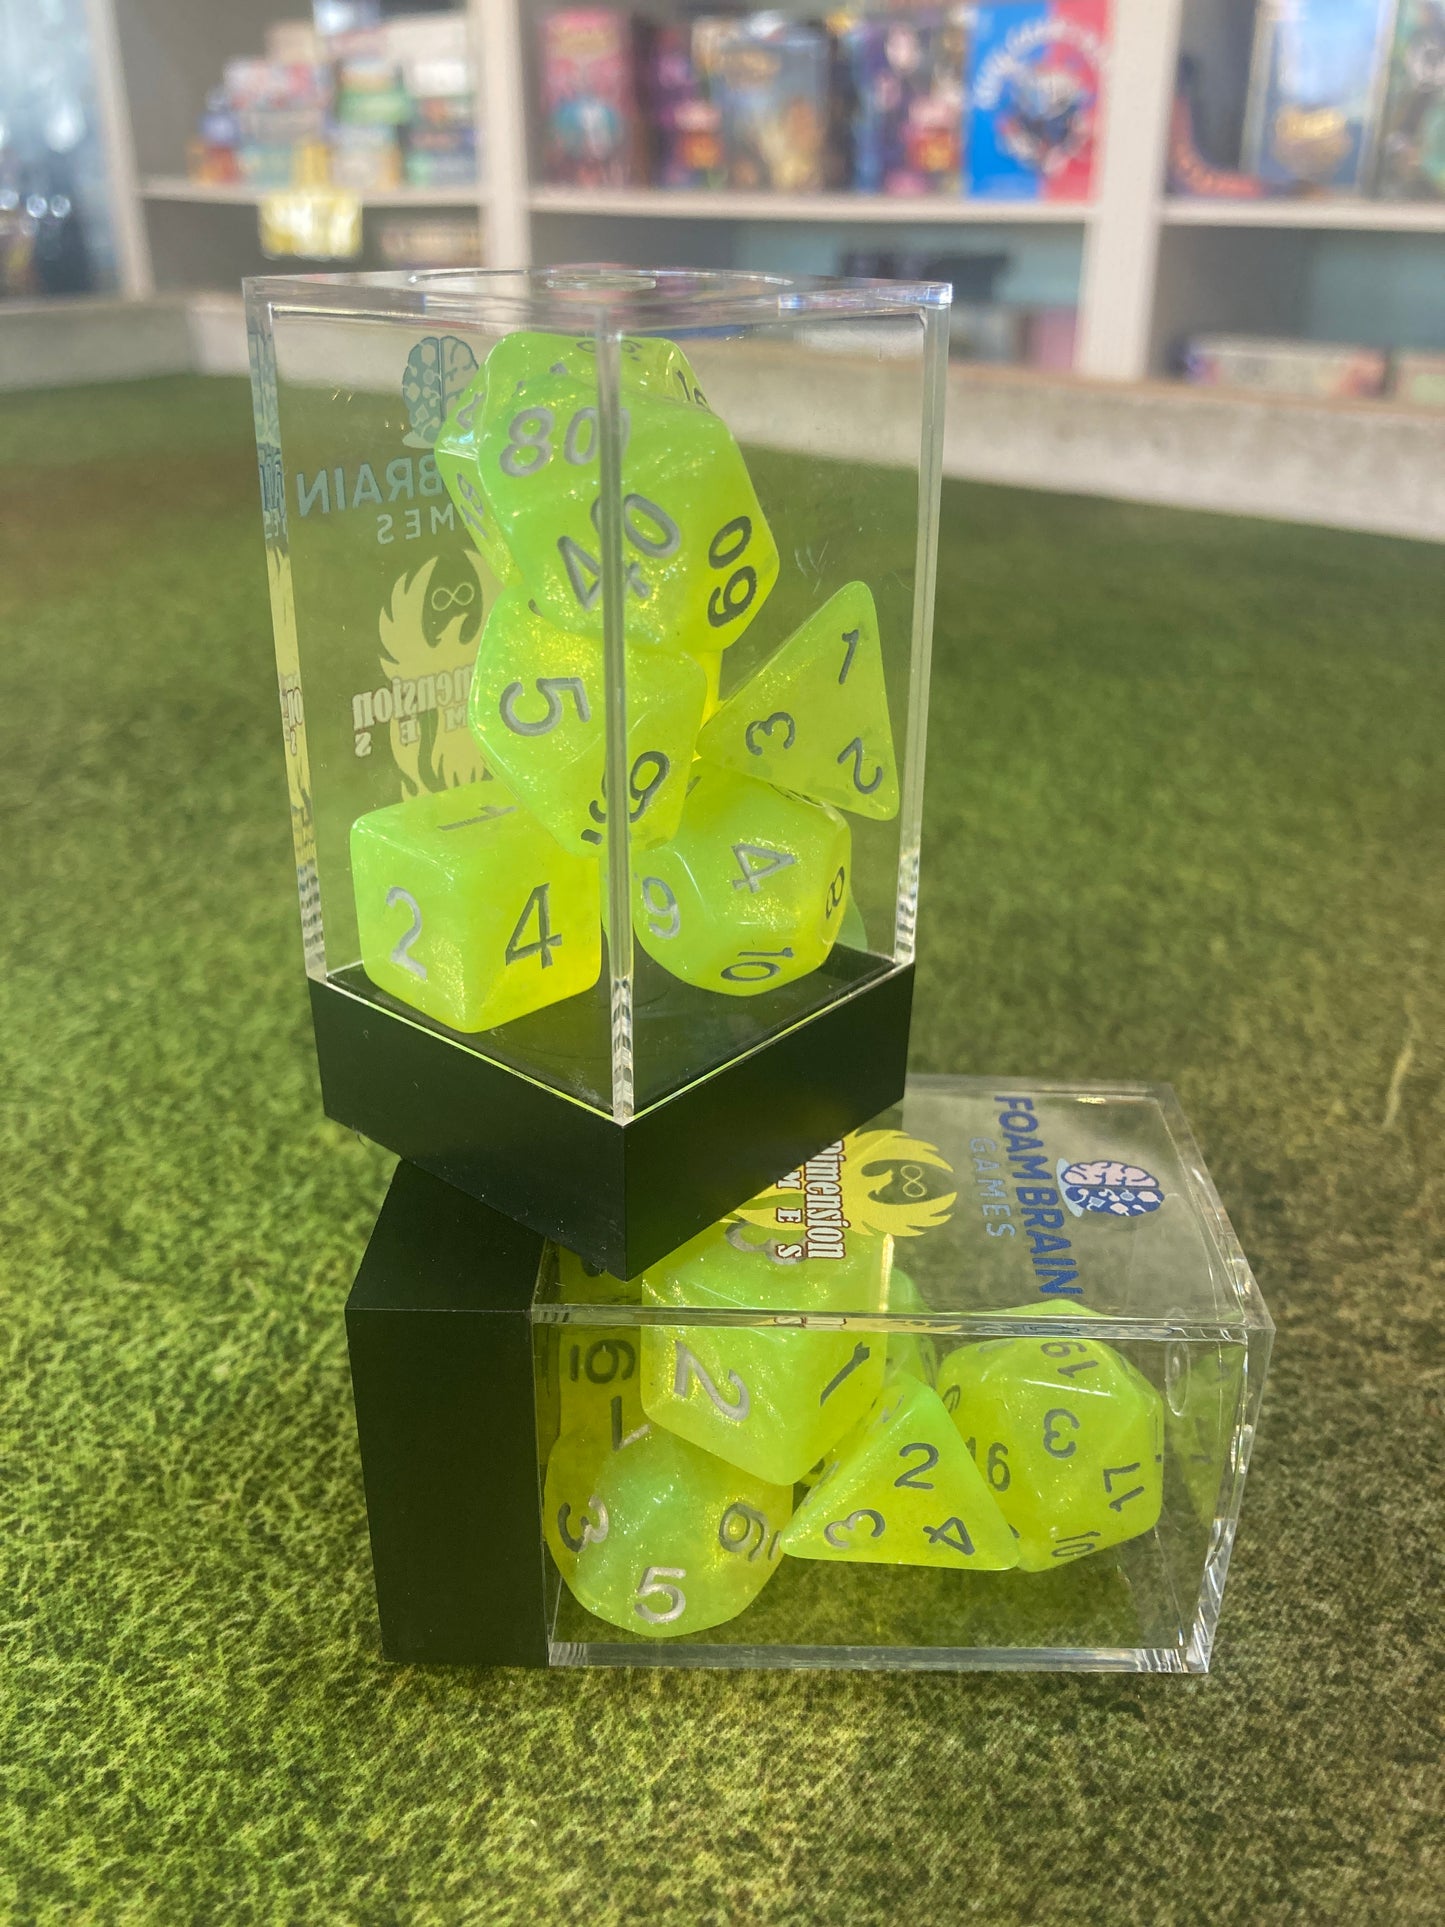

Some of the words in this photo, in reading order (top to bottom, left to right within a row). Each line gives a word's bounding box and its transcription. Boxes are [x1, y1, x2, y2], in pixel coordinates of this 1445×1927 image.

[500, 407, 630, 477] 80
[841, 628, 859, 685] 1
[499, 676, 591, 737] 5
[745, 711, 796, 756] 3
[837, 737, 883, 795] 2
[730, 843, 796, 894] 4
[825, 866, 846, 920] 8
[385, 886, 428, 981] 2
[504, 881, 563, 969] 4
[720, 945, 795, 982] 10
[775, 1169, 803, 1260] MES
[970, 1136, 1017, 1238] GAMES
[673, 1340, 750, 1421] 2
[819, 1341, 870, 1407] 1
[1040, 1340, 1099, 1379] 19
[1042, 1407, 1081, 1459] 3
[893, 1442, 940, 1490] 2
[1102, 1461, 1145, 1513] 17
[557, 1495, 609, 1553] 3
[823, 1508, 886, 1549] 3
[922, 1515, 976, 1557] 4
[1051, 1530, 1102, 1558] 10
[634, 1565, 687, 1624] 5
